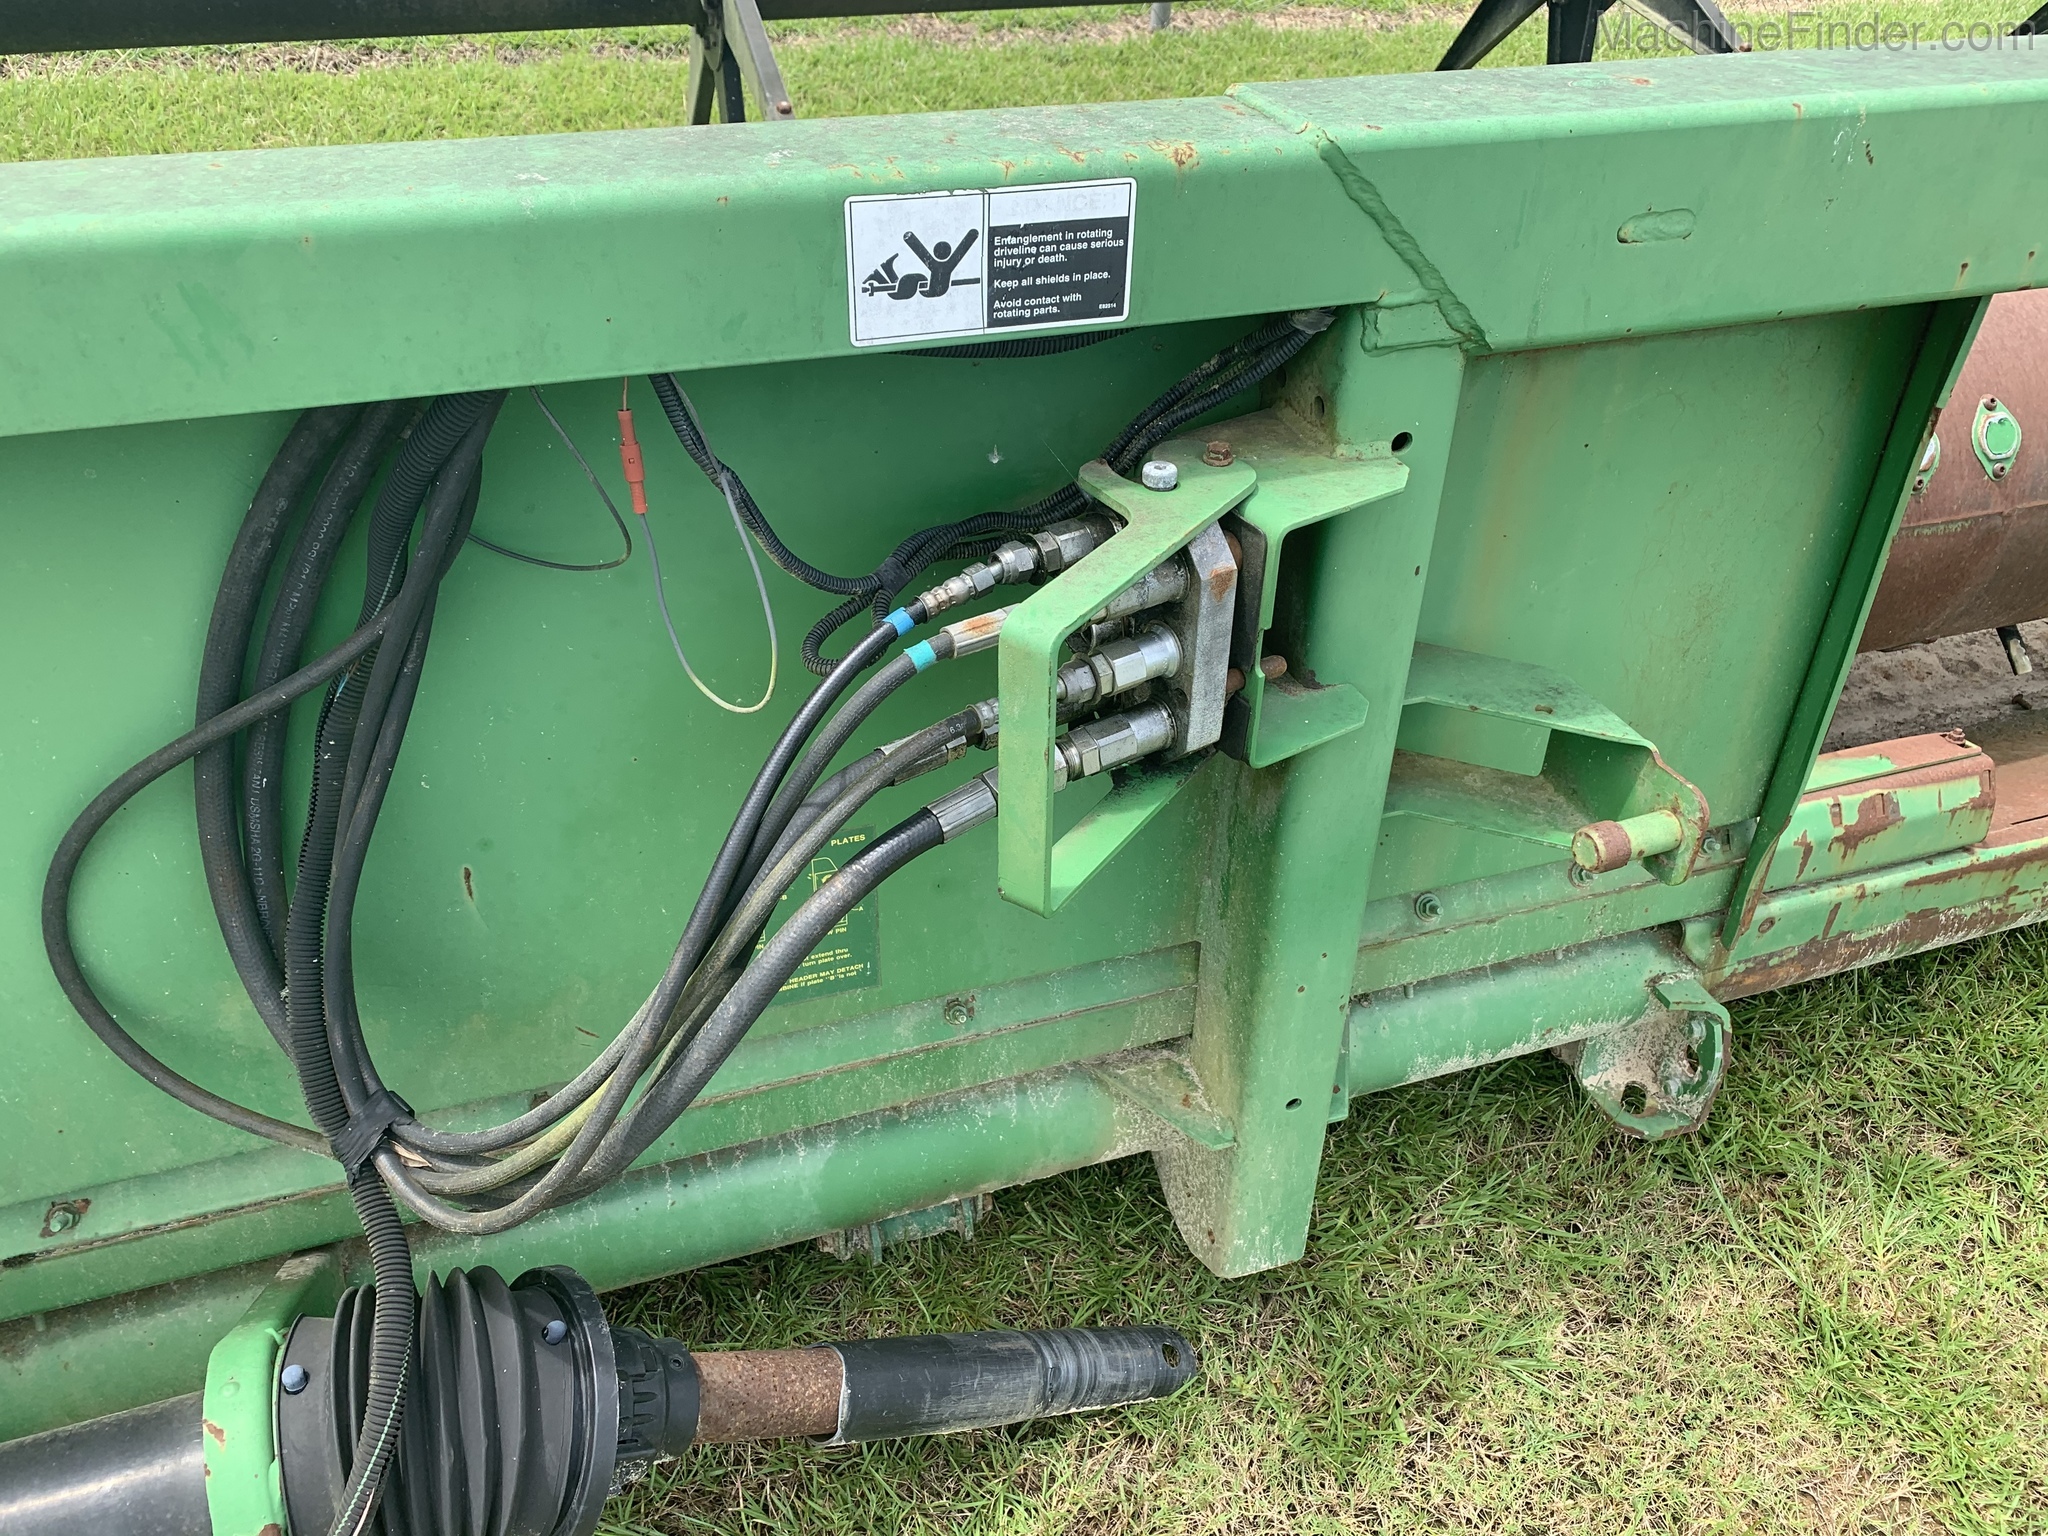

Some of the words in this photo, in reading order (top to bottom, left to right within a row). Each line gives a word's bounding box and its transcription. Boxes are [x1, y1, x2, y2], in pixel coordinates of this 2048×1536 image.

[994, 231, 1063, 246] Entanglement
[1065, 231, 1074, 240] in
[1077, 228, 1113, 240] rotating
[993, 245, 1037, 257] driveline
[1039, 244, 1057, 253] can
[1059, 241, 1088, 252] cause
[1090, 239, 1125, 248] serious
[993, 257, 1022, 269] injury
[1024, 256, 1036, 265] or
[1037, 253, 1068, 264] death.
[994, 279, 1019, 290] Keep
[1021, 276, 1033, 286] all
[1035, 273, 1070, 285] shields
[1083, 271, 1111, 282] place.
[993, 297, 1022, 309] Avoid
[1024, 295, 1060, 306] contact
[1062, 292, 1082, 303] with
[993, 307, 1031, 319] rotating
[1033, 305, 1061, 317] parts.
[830, 834, 866, 847] PLATES
[811, 951, 833, 959] extend
[835, 947, 849, 955] thru
[818, 956, 834, 965] plate
[789, 973, 818, 983] HEADER
[819, 969, 835, 977] MAY
[836, 963, 864, 974] DETACH
[807, 978, 824, 986] plate
